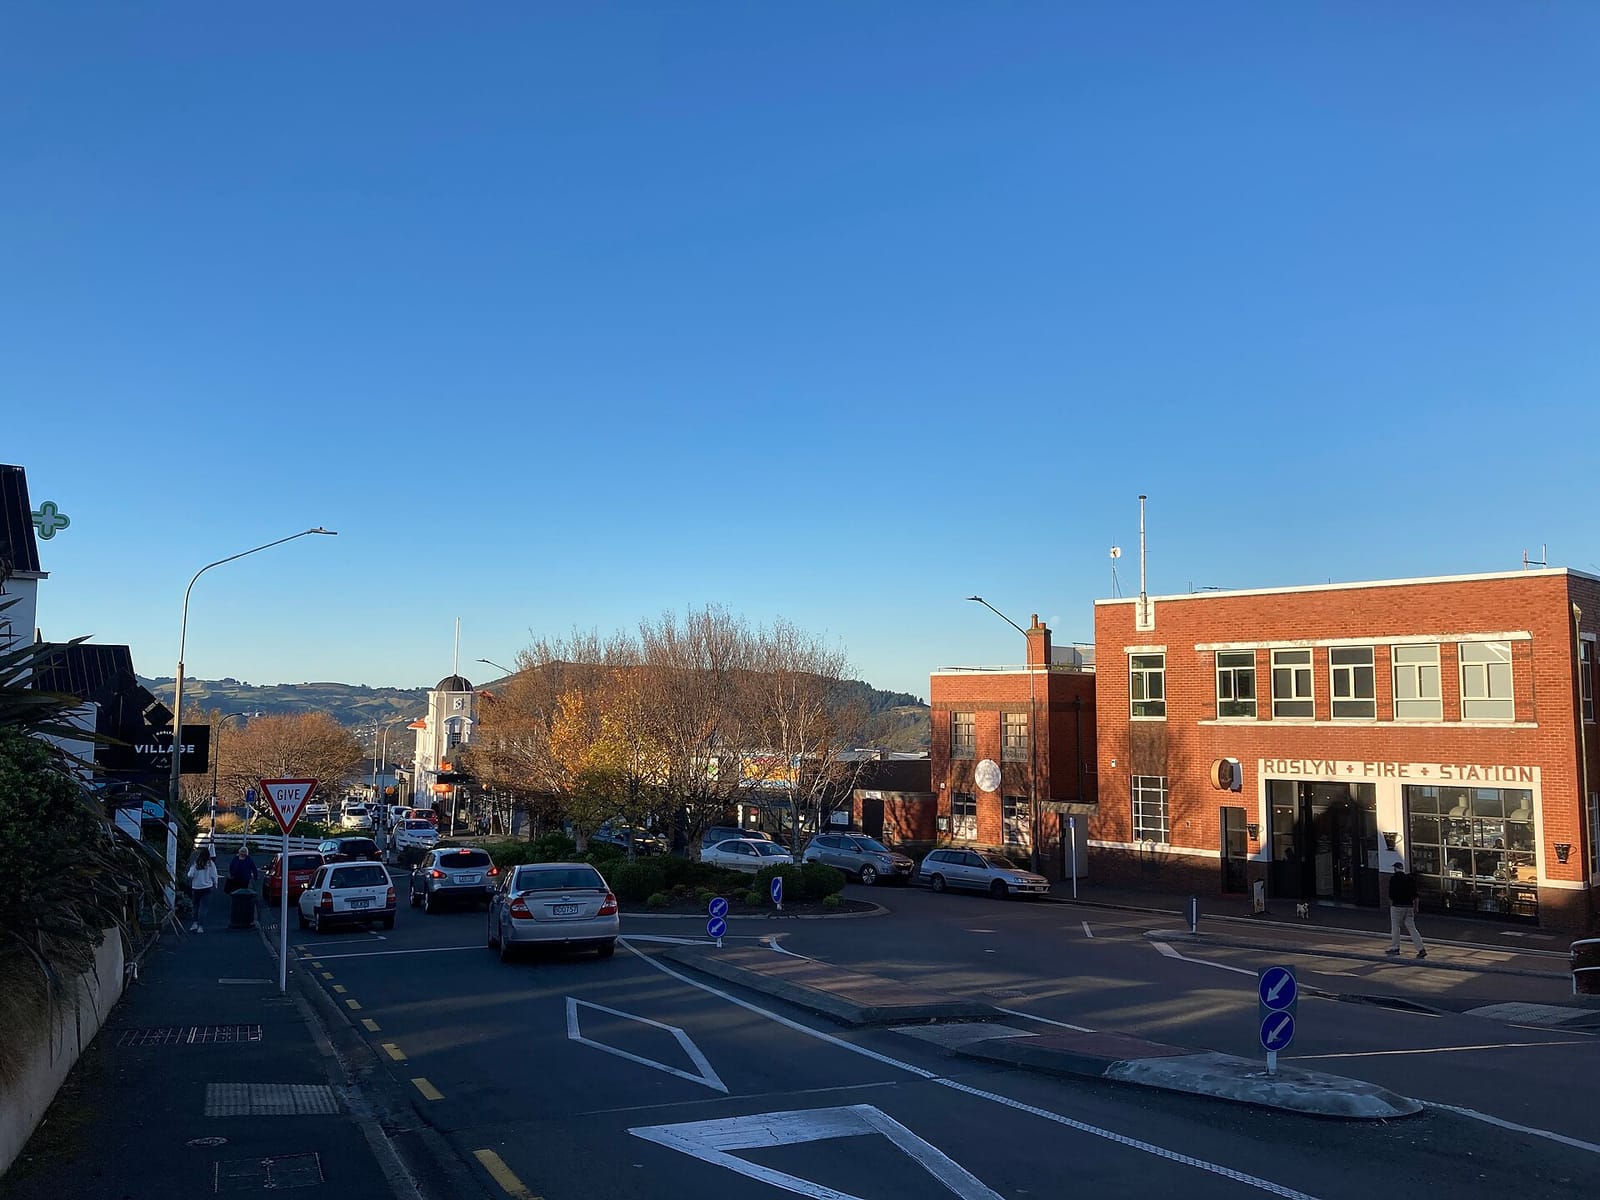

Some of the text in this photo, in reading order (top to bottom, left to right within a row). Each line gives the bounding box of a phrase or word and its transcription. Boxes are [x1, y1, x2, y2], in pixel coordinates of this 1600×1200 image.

[1263, 759, 1533, 782] ROSLYN FIRE STATION
[277, 789, 301, 801] GIVE
[281, 804, 296, 814] WAY
